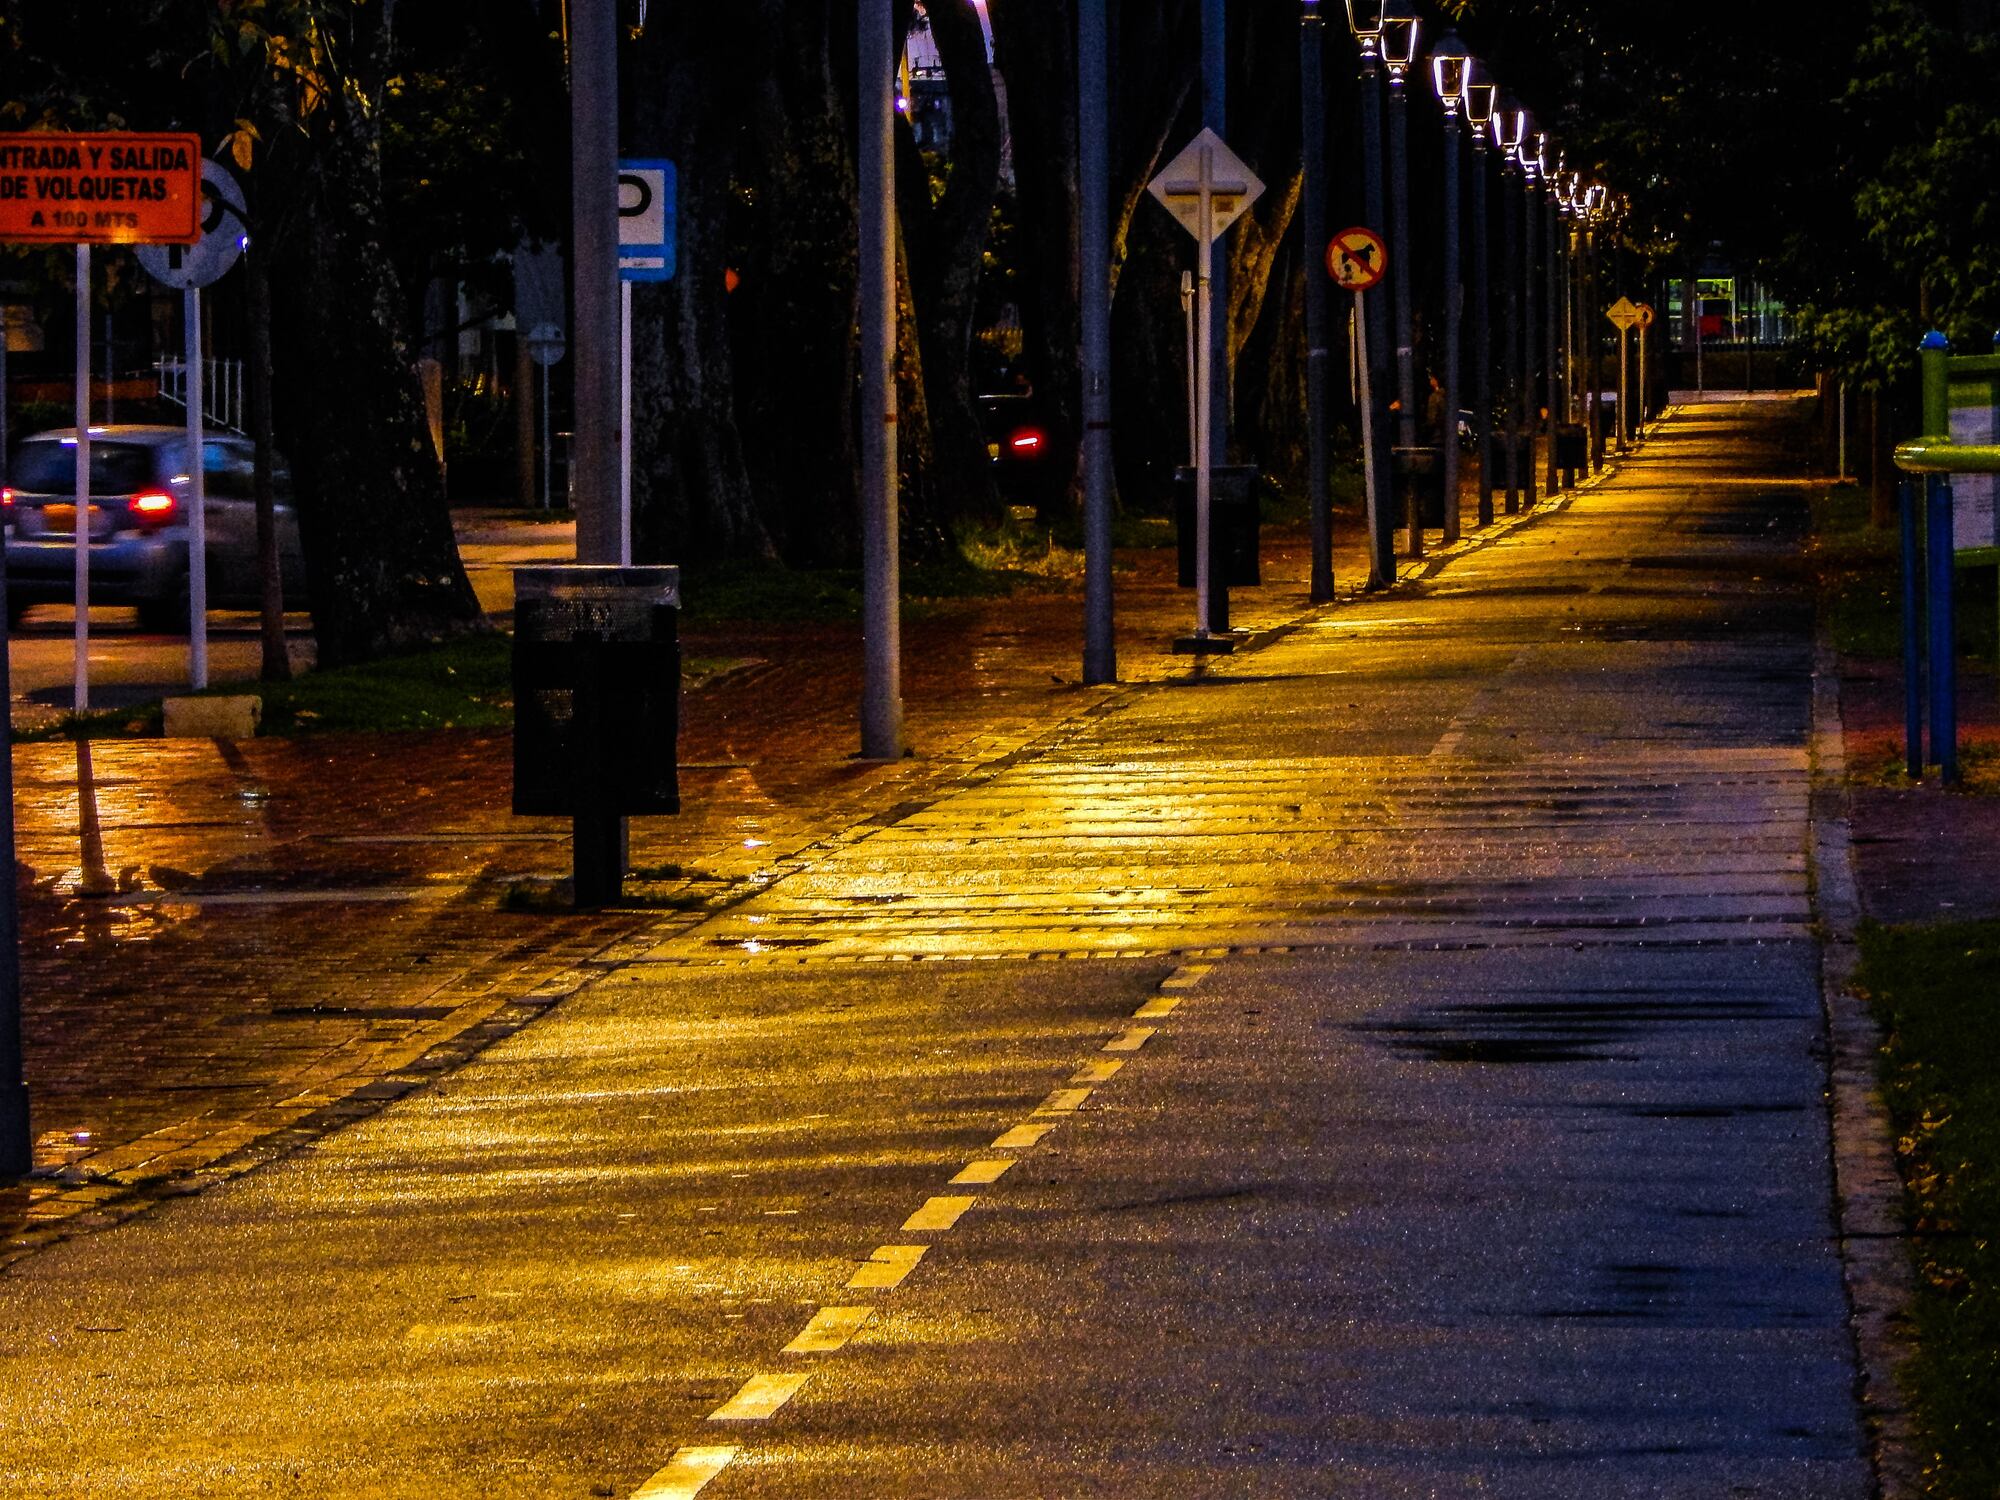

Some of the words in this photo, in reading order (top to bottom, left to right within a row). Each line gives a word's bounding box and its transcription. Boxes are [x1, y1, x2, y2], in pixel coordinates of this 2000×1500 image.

[88, 147, 103, 170] Y
[110, 147, 189, 171] SALIDA
[1, 175, 29, 199] DE
[35, 176, 167, 201] VOLQUETAS
[31, 211, 45, 227] A
[52, 211, 88, 227] 100
[94, 211, 139, 229] MTS
